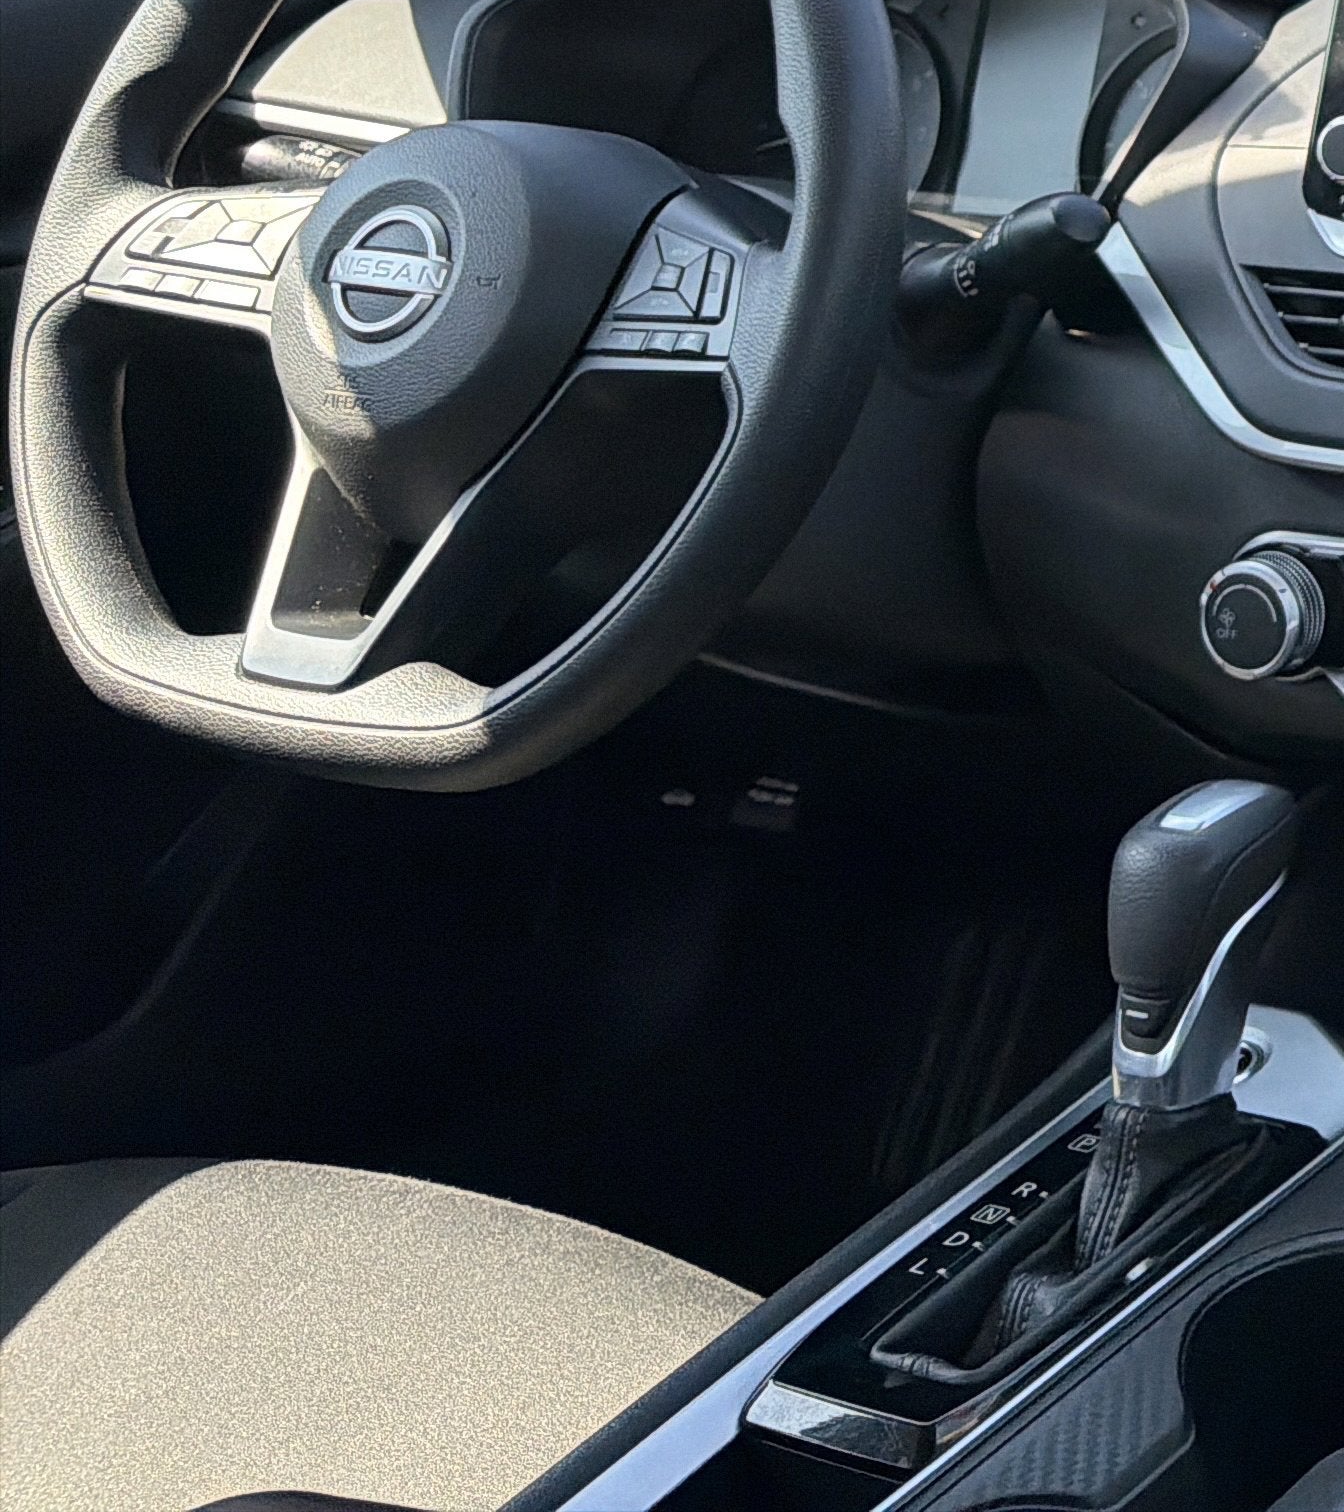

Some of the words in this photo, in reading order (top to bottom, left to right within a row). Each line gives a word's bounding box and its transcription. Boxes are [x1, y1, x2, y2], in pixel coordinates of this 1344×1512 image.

[330, 254, 448, 290] NISSAN
[1011, 1181, 1038, 1199] R
[942, 1231, 969, 1247] D
[908, 1257, 930, 1276] L
